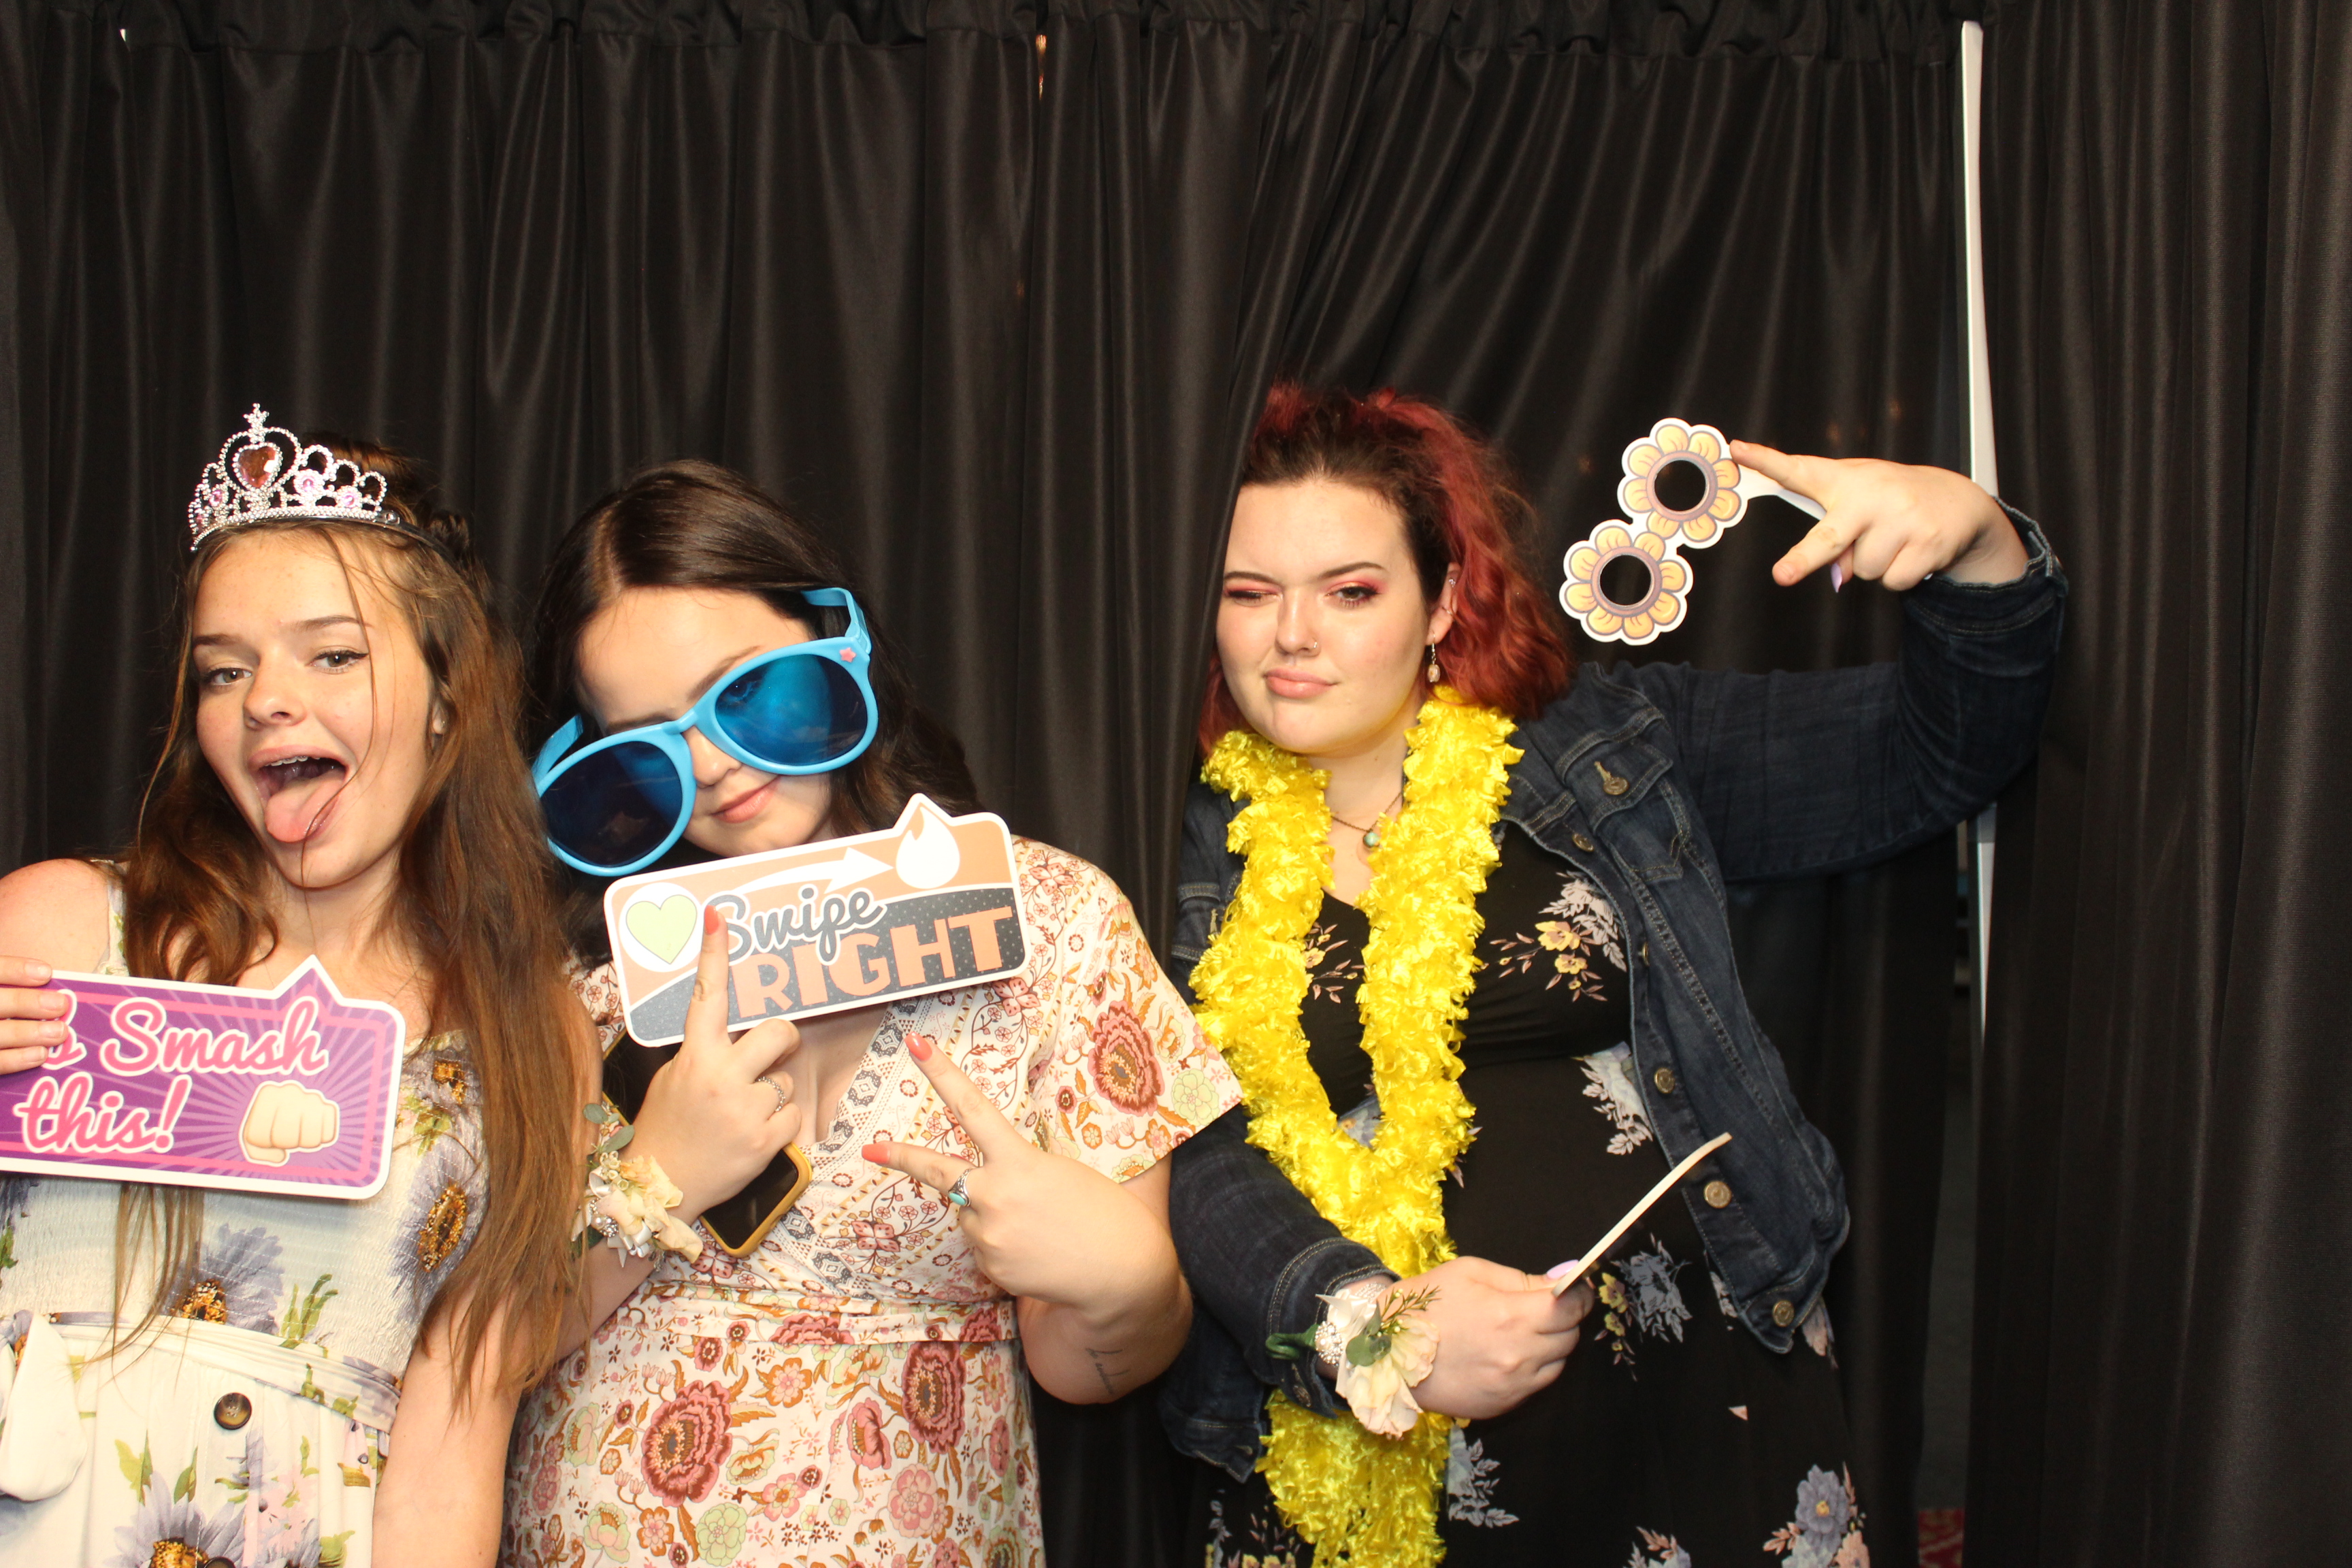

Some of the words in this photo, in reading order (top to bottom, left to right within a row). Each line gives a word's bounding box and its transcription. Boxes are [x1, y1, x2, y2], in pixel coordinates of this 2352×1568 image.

[705, 885, 886, 964] Swipe
[732, 906, 1013, 1019] RIGHT
[100, 996, 329, 1075] Smash
[13, 1073, 192, 1153] this!
